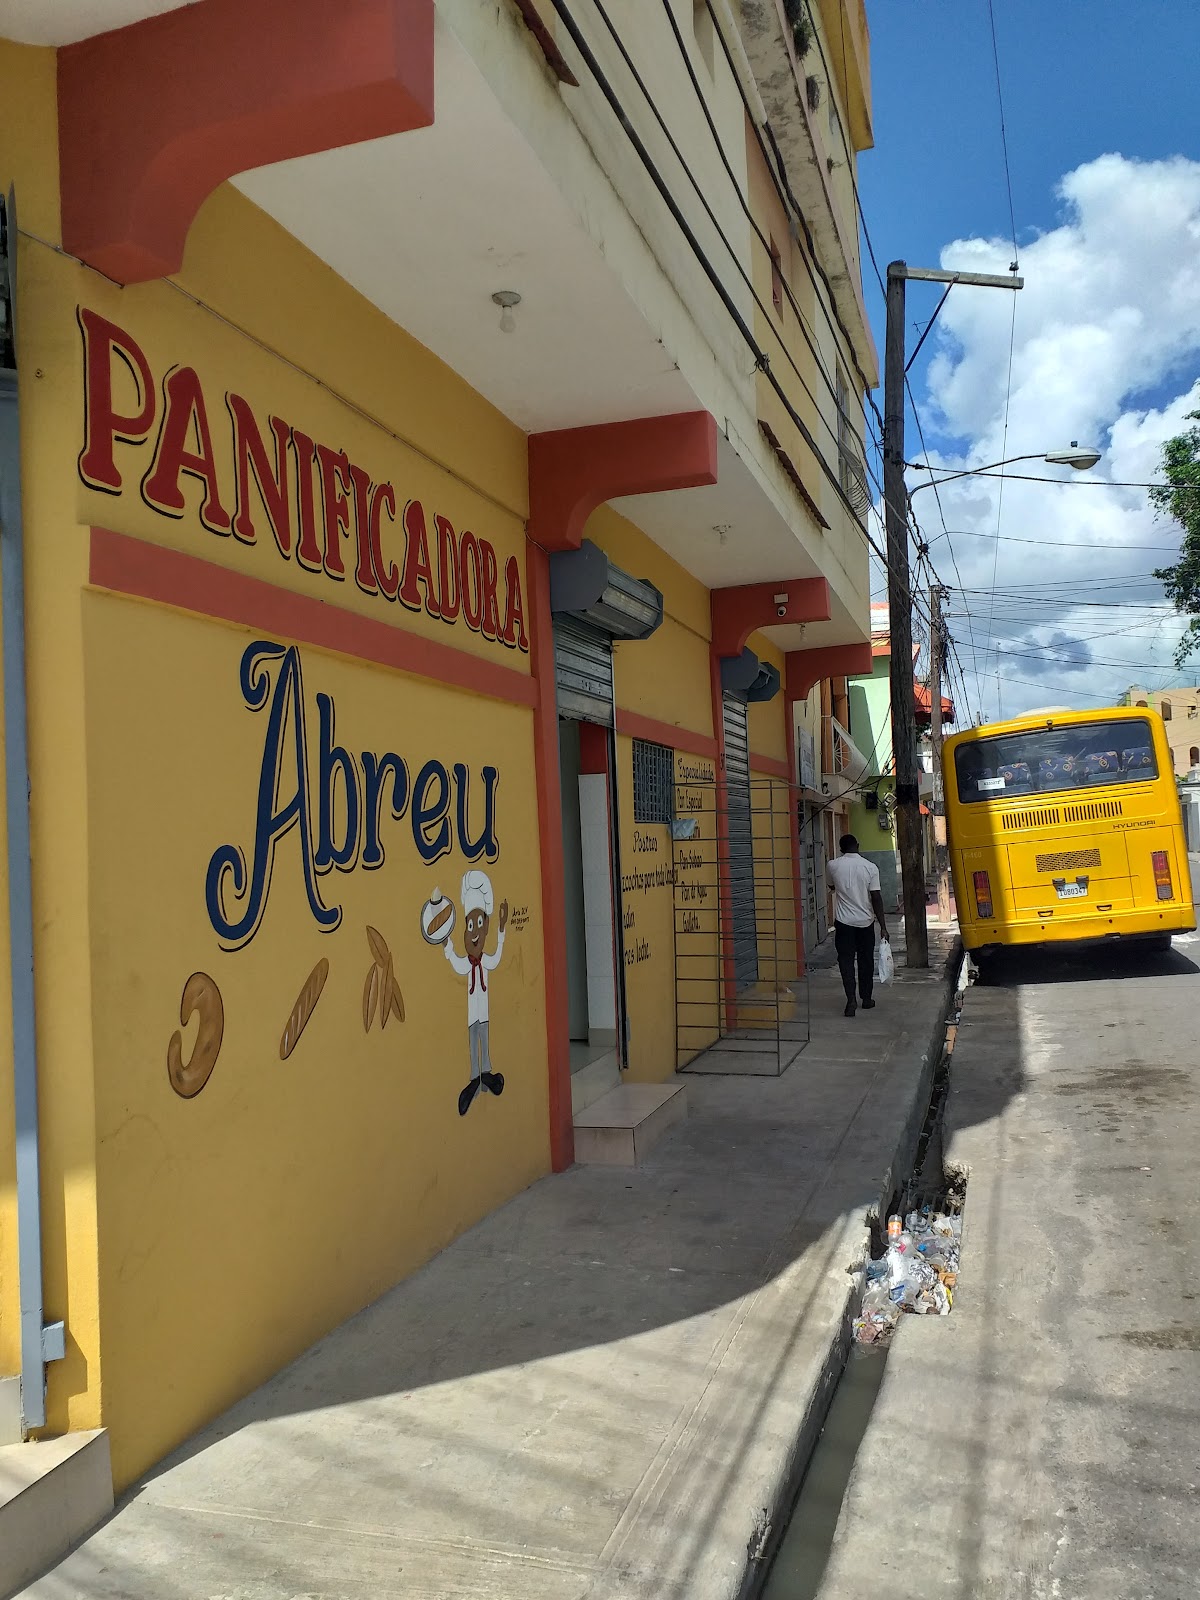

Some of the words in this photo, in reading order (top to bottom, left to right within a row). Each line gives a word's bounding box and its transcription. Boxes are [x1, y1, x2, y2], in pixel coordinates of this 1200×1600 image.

[77, 304, 528, 653] PANIFICADORA
[205, 640, 500, 952] Abreu
[632, 830, 658, 852] Postres
[1112, 820, 1156, 829] HYUNDAI
